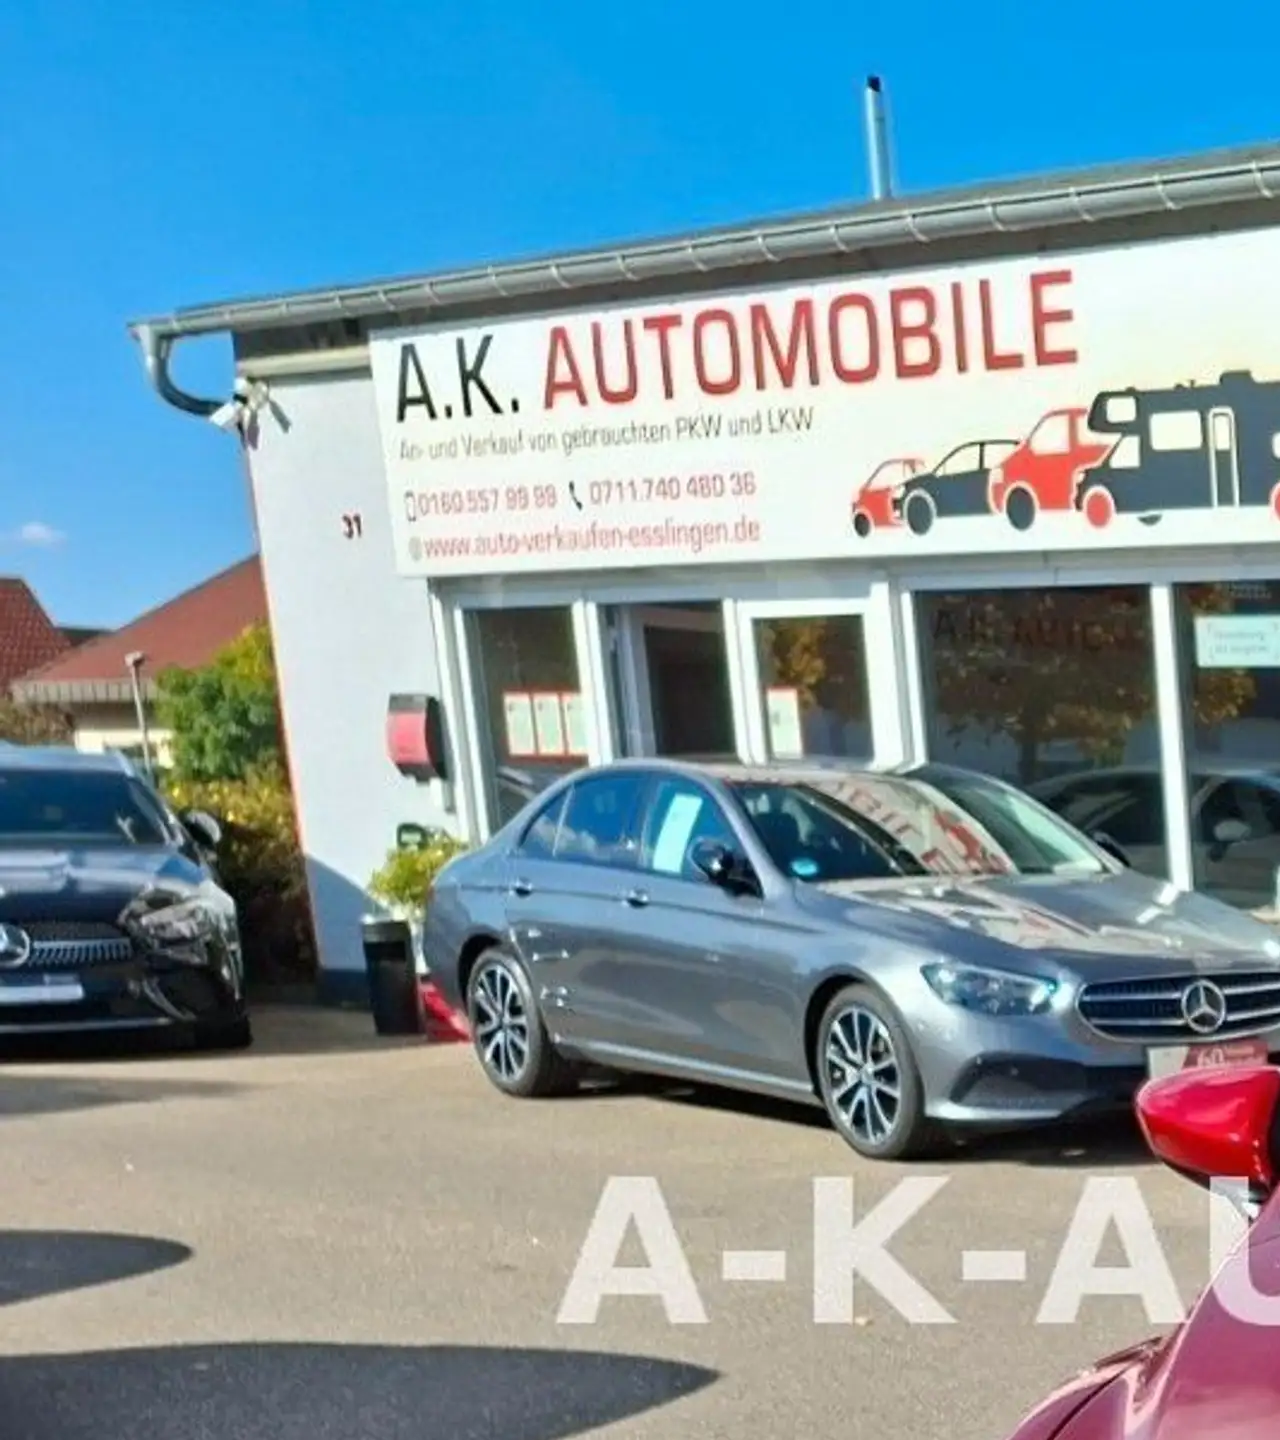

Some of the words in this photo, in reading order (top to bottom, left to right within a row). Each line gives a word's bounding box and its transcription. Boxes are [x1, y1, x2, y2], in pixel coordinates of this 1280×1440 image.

[397, 334, 520, 423] A.K.
[544, 269, 1078, 410] AUTOMOBILE
[429, 436, 458, 459] und
[462, 428, 522, 457] Verkauf
[529, 431, 557, 453] von
[562, 418, 670, 457] gebrauchten
[676, 413, 722, 441] PKW
[728, 410, 762, 437] und
[768, 406, 814, 433] LKW
[341, 513, 362, 540] 31
[423, 514, 761, 558] www.auto-verkaufen-esslingen.de
